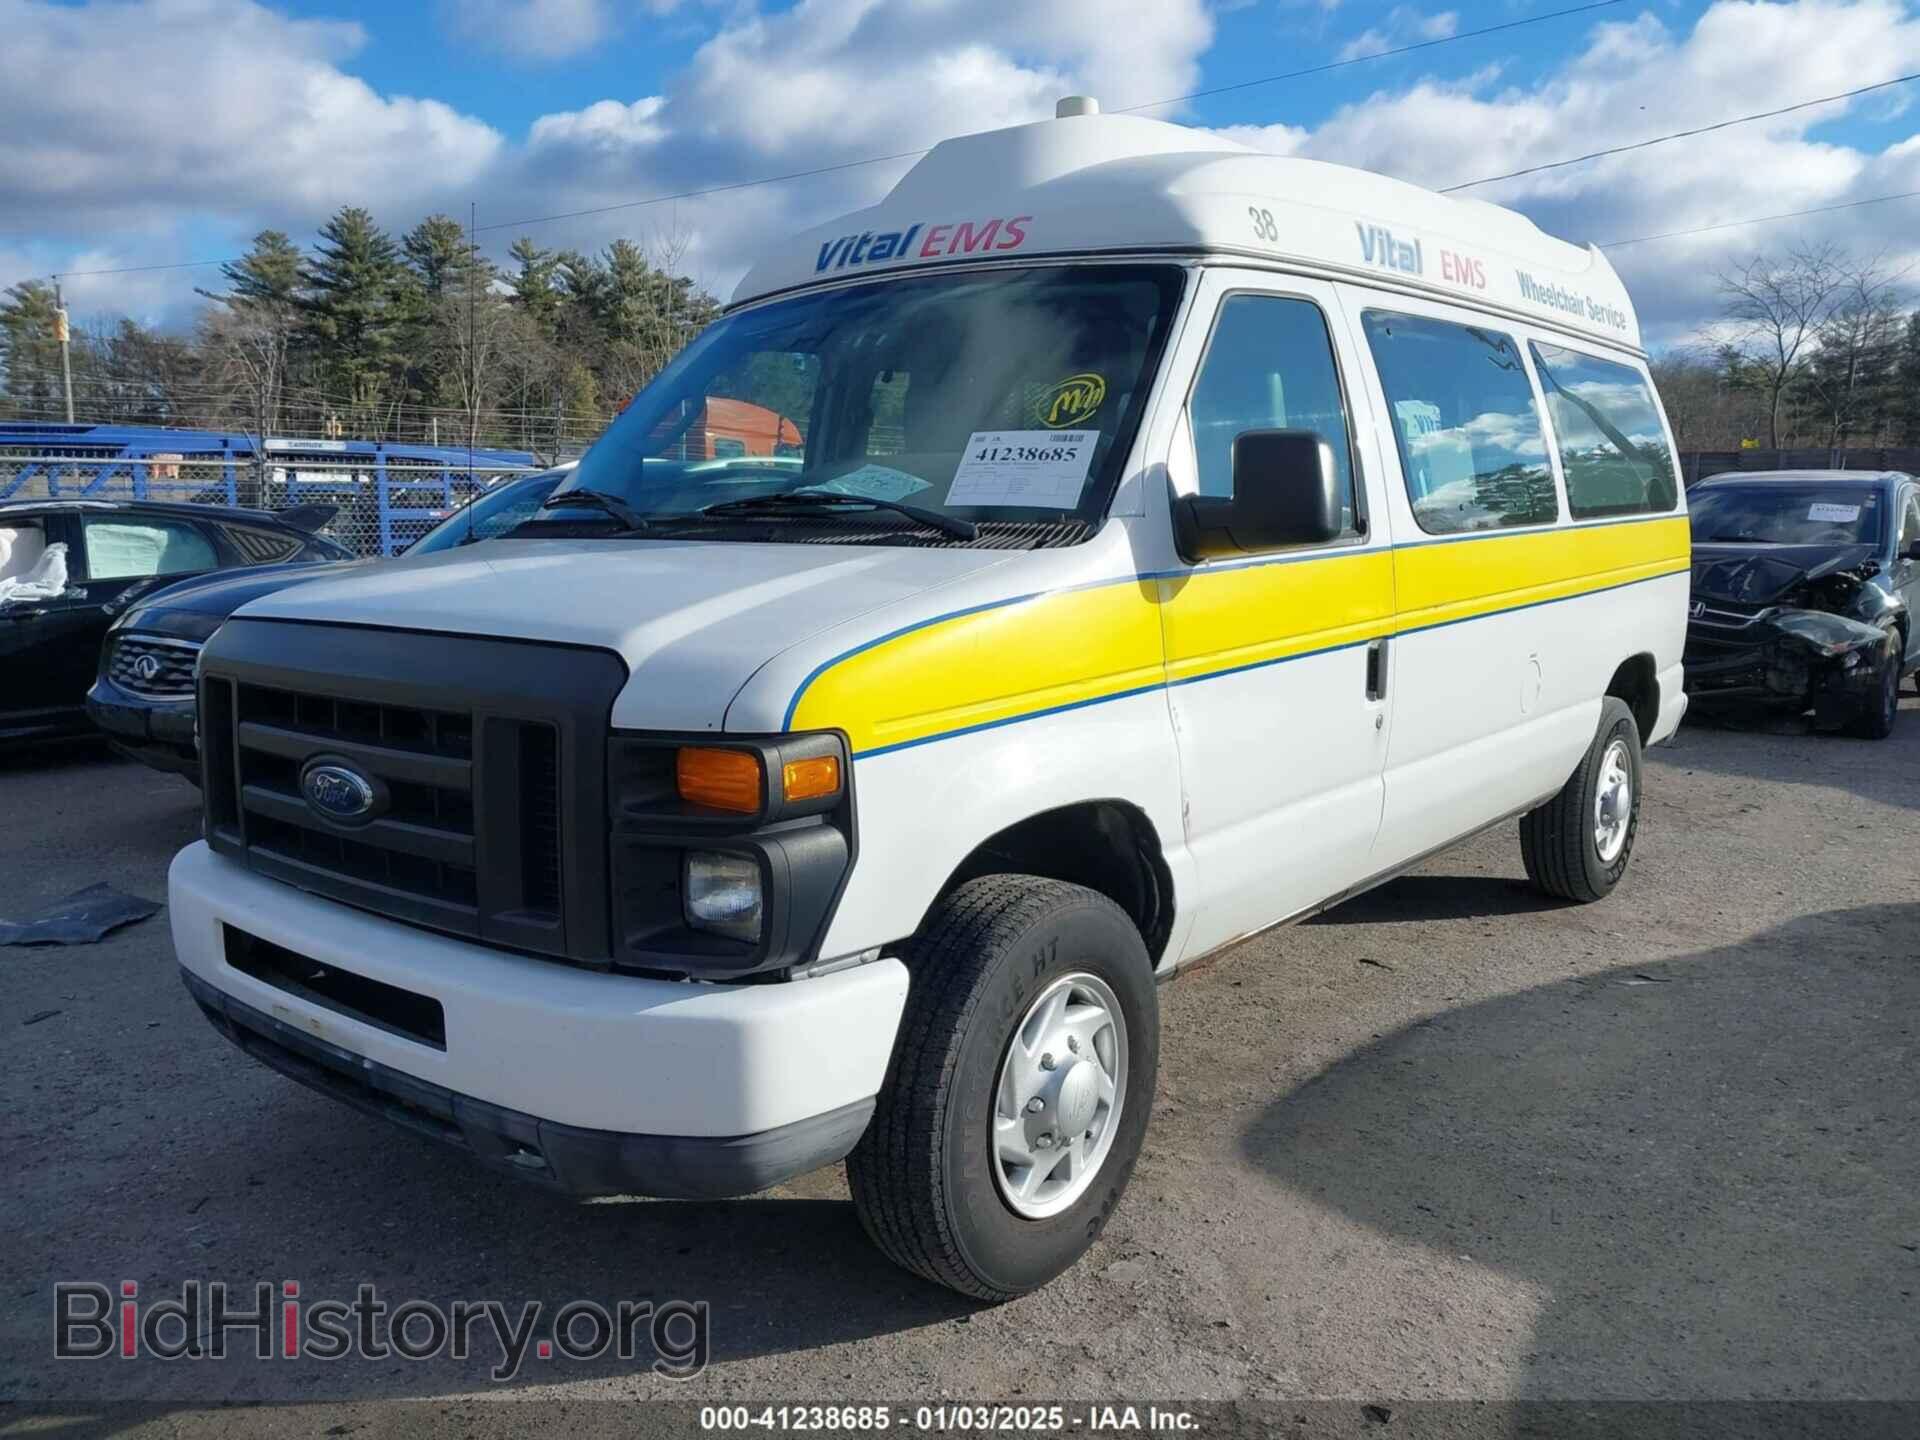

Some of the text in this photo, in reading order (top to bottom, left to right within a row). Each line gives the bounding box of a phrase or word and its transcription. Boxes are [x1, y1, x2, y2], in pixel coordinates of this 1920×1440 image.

[816, 215, 1033, 272] Vital EMS
[1248, 206, 1278, 241] 38
[1354, 220, 1487, 290] Vital EMS
[1515, 269, 1627, 331] Wheelchair Service
[976, 447, 1078, 462] 41238685
